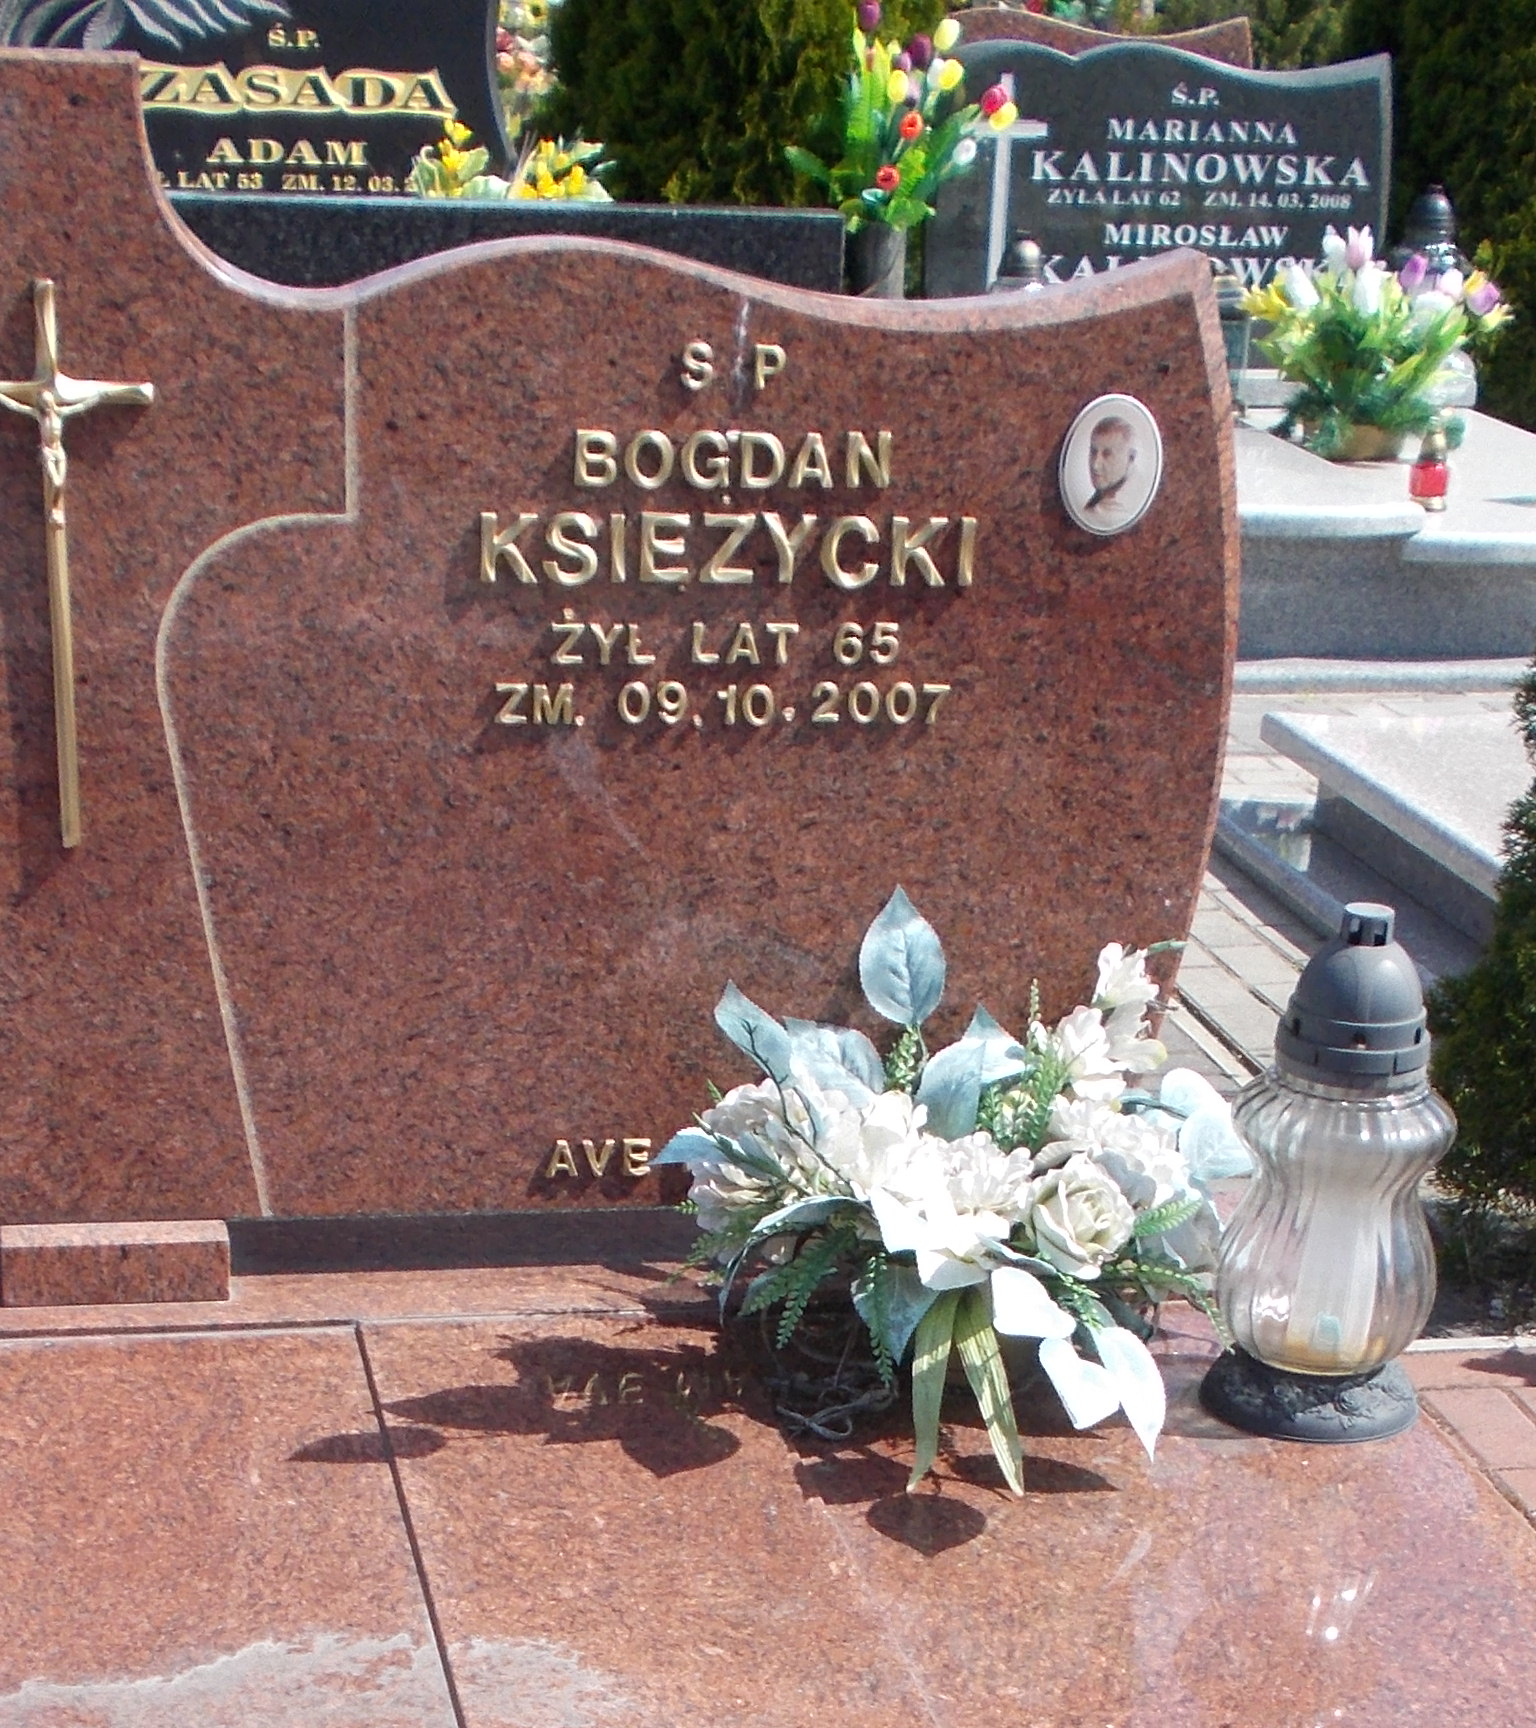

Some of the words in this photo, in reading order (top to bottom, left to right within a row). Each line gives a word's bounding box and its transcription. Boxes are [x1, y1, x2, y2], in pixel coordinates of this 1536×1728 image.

[138, 61, 457, 117] ZASADA
[1108, 117, 1298, 145] MARIANNA
[206, 137, 369, 166] ADAM
[1031, 149, 1370, 187] KALINOWSKA
[177, 171, 230, 191] LAT
[236, 171, 263, 190] 53
[281, 172, 325, 191] ZM.
[1112, 188, 1154, 205] LAT
[1104, 222, 1289, 247] MIROSŁAW
[752, 343, 788, 391] P
[573, 428, 894, 490] BOGDAN
[550, 608, 656, 666] ŻYŁ
[690, 621, 801, 665] LAT
[833, 621, 900, 666] 65
[494, 681, 585, 727] ZM.
[545, 1137, 652, 1178] AVE
